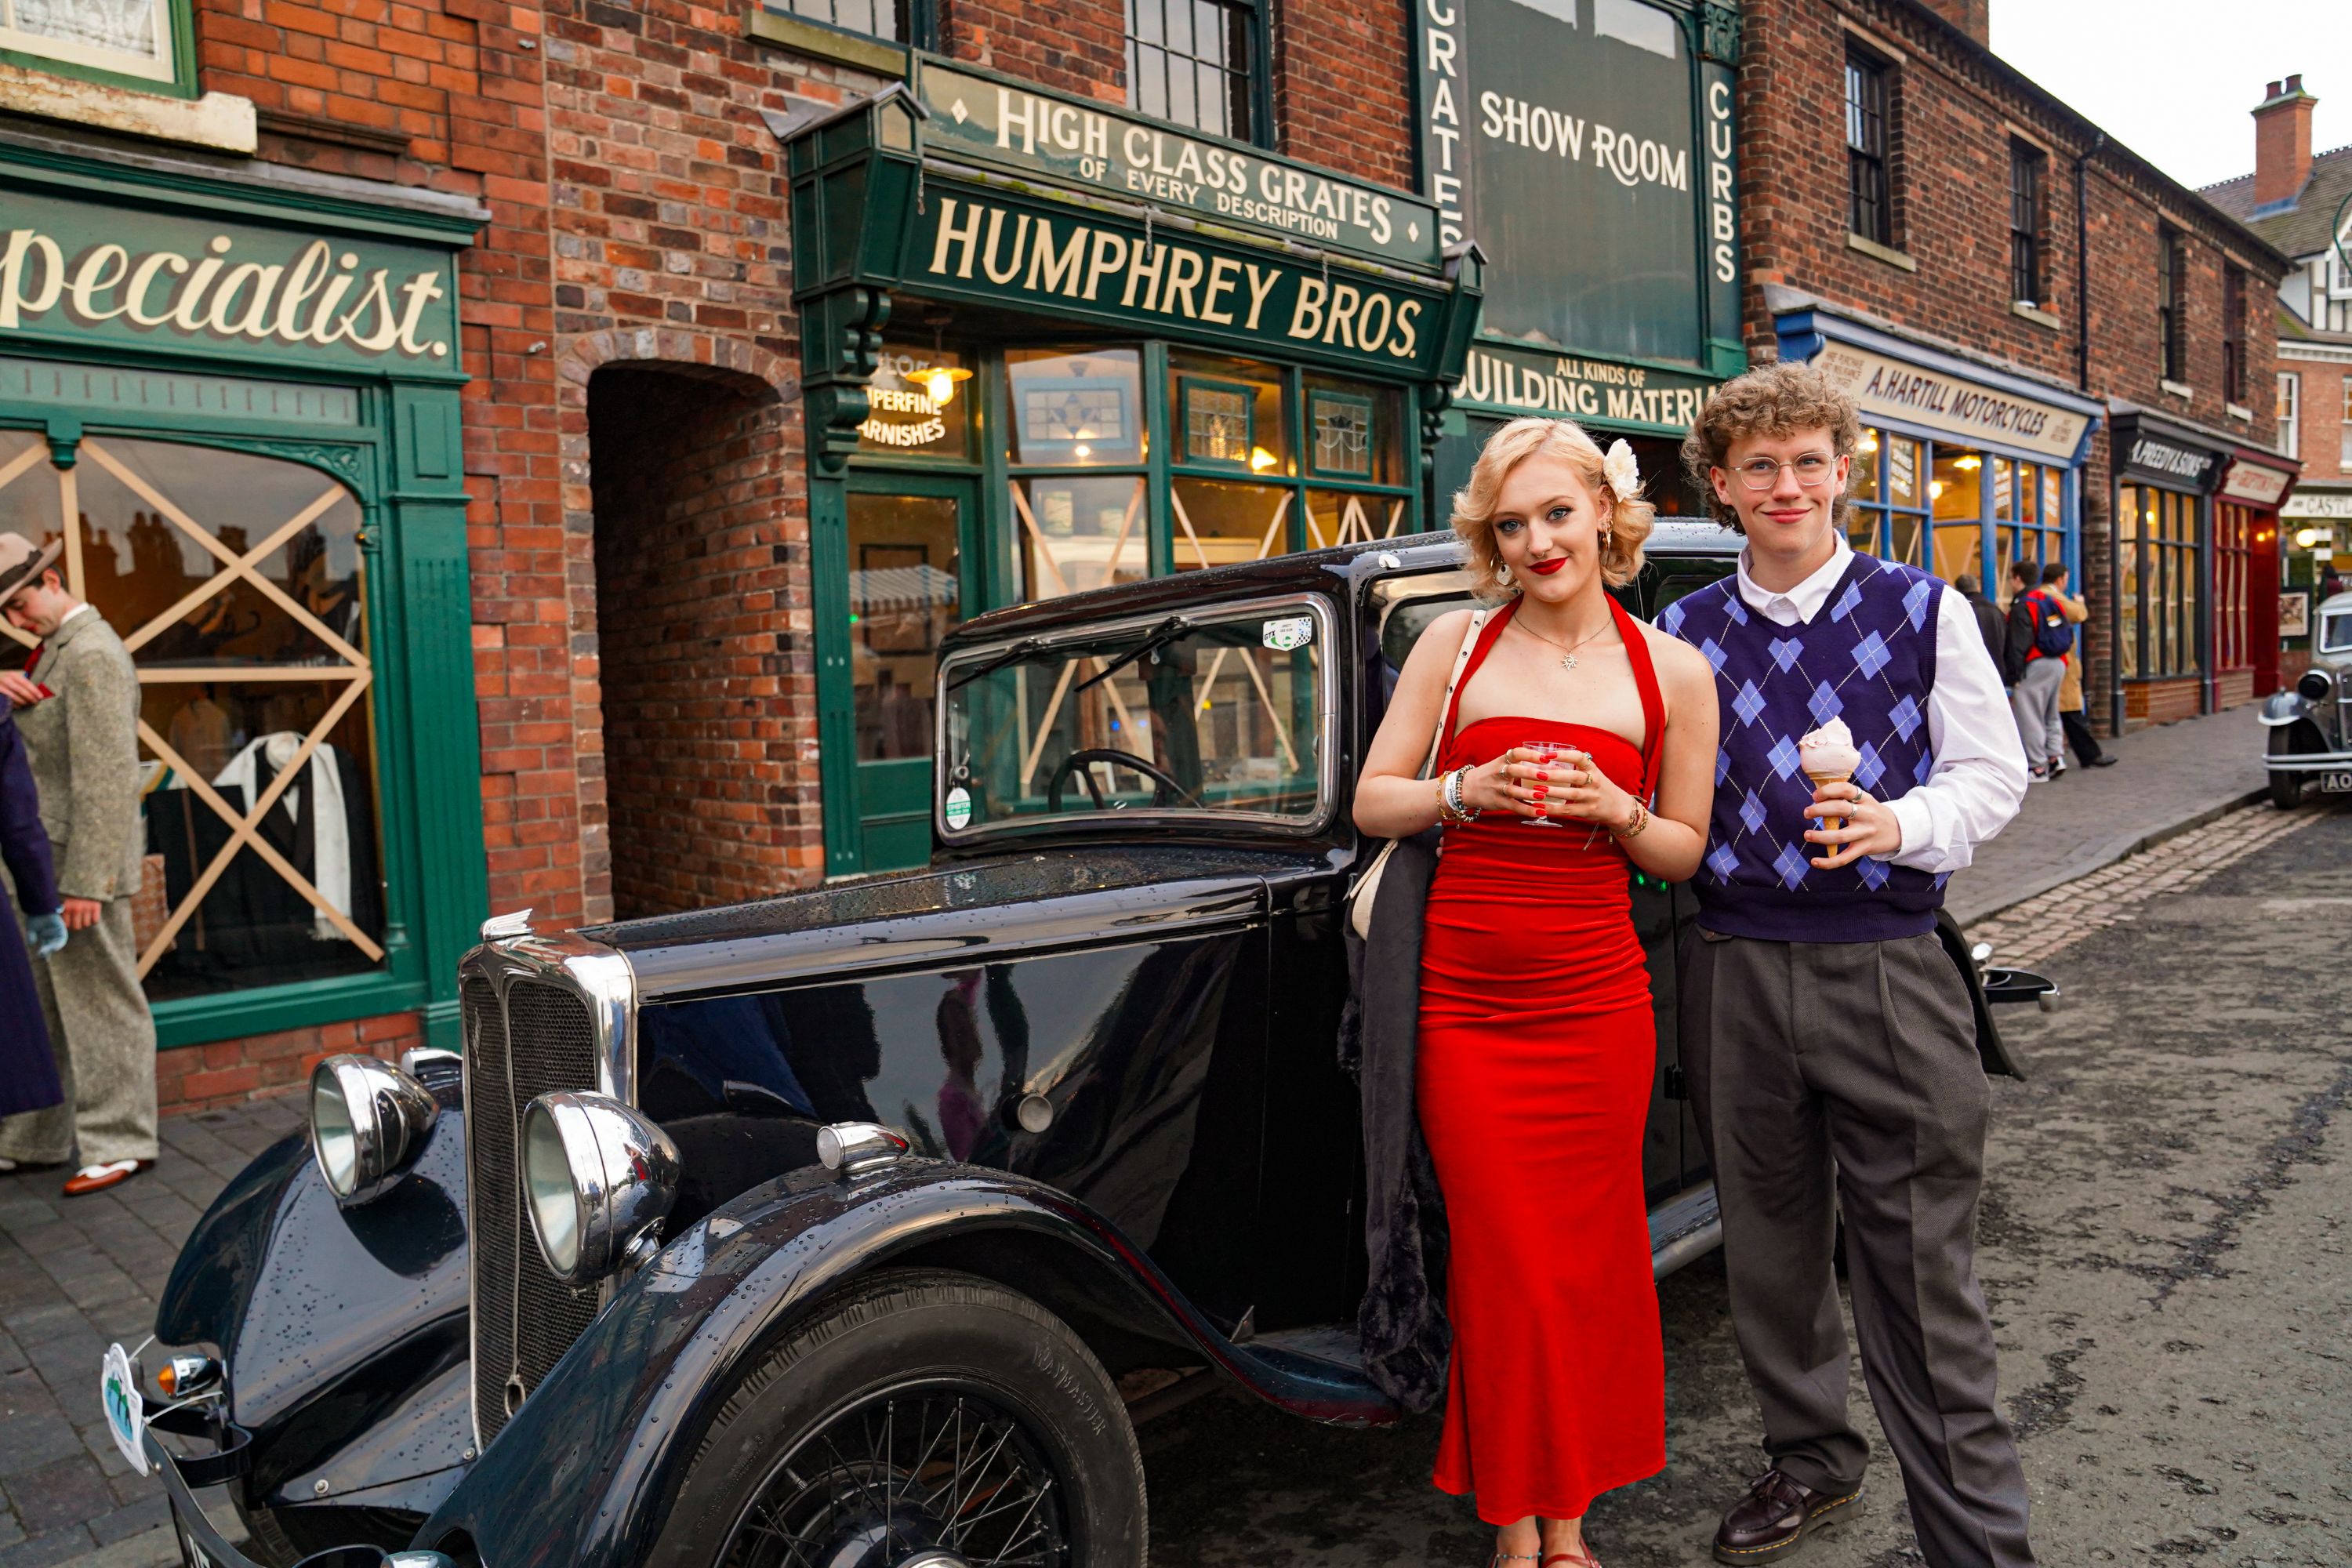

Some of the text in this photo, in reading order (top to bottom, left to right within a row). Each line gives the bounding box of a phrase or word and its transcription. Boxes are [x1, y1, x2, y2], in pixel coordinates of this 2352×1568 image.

[996, 88, 1392, 245] HIGH CLASS GRATES
[1481, 91, 1688, 191] SHOW ROOM
[1709, 82, 1736, 283] CURBS
[1080, 157, 1338, 240] OF EVERY DESCRIPTION
[0, 229, 448, 357] pecialist.
[929, 198, 1422, 360] HUMPHREY BROS.
[1555, 358, 1646, 388] ALL KINDS OF
[1949, 389, 2049, 437] MOTORCYCLES
[856, 417, 946, 447] ARNISHES
[1264, 630, 1276, 641] GTX
